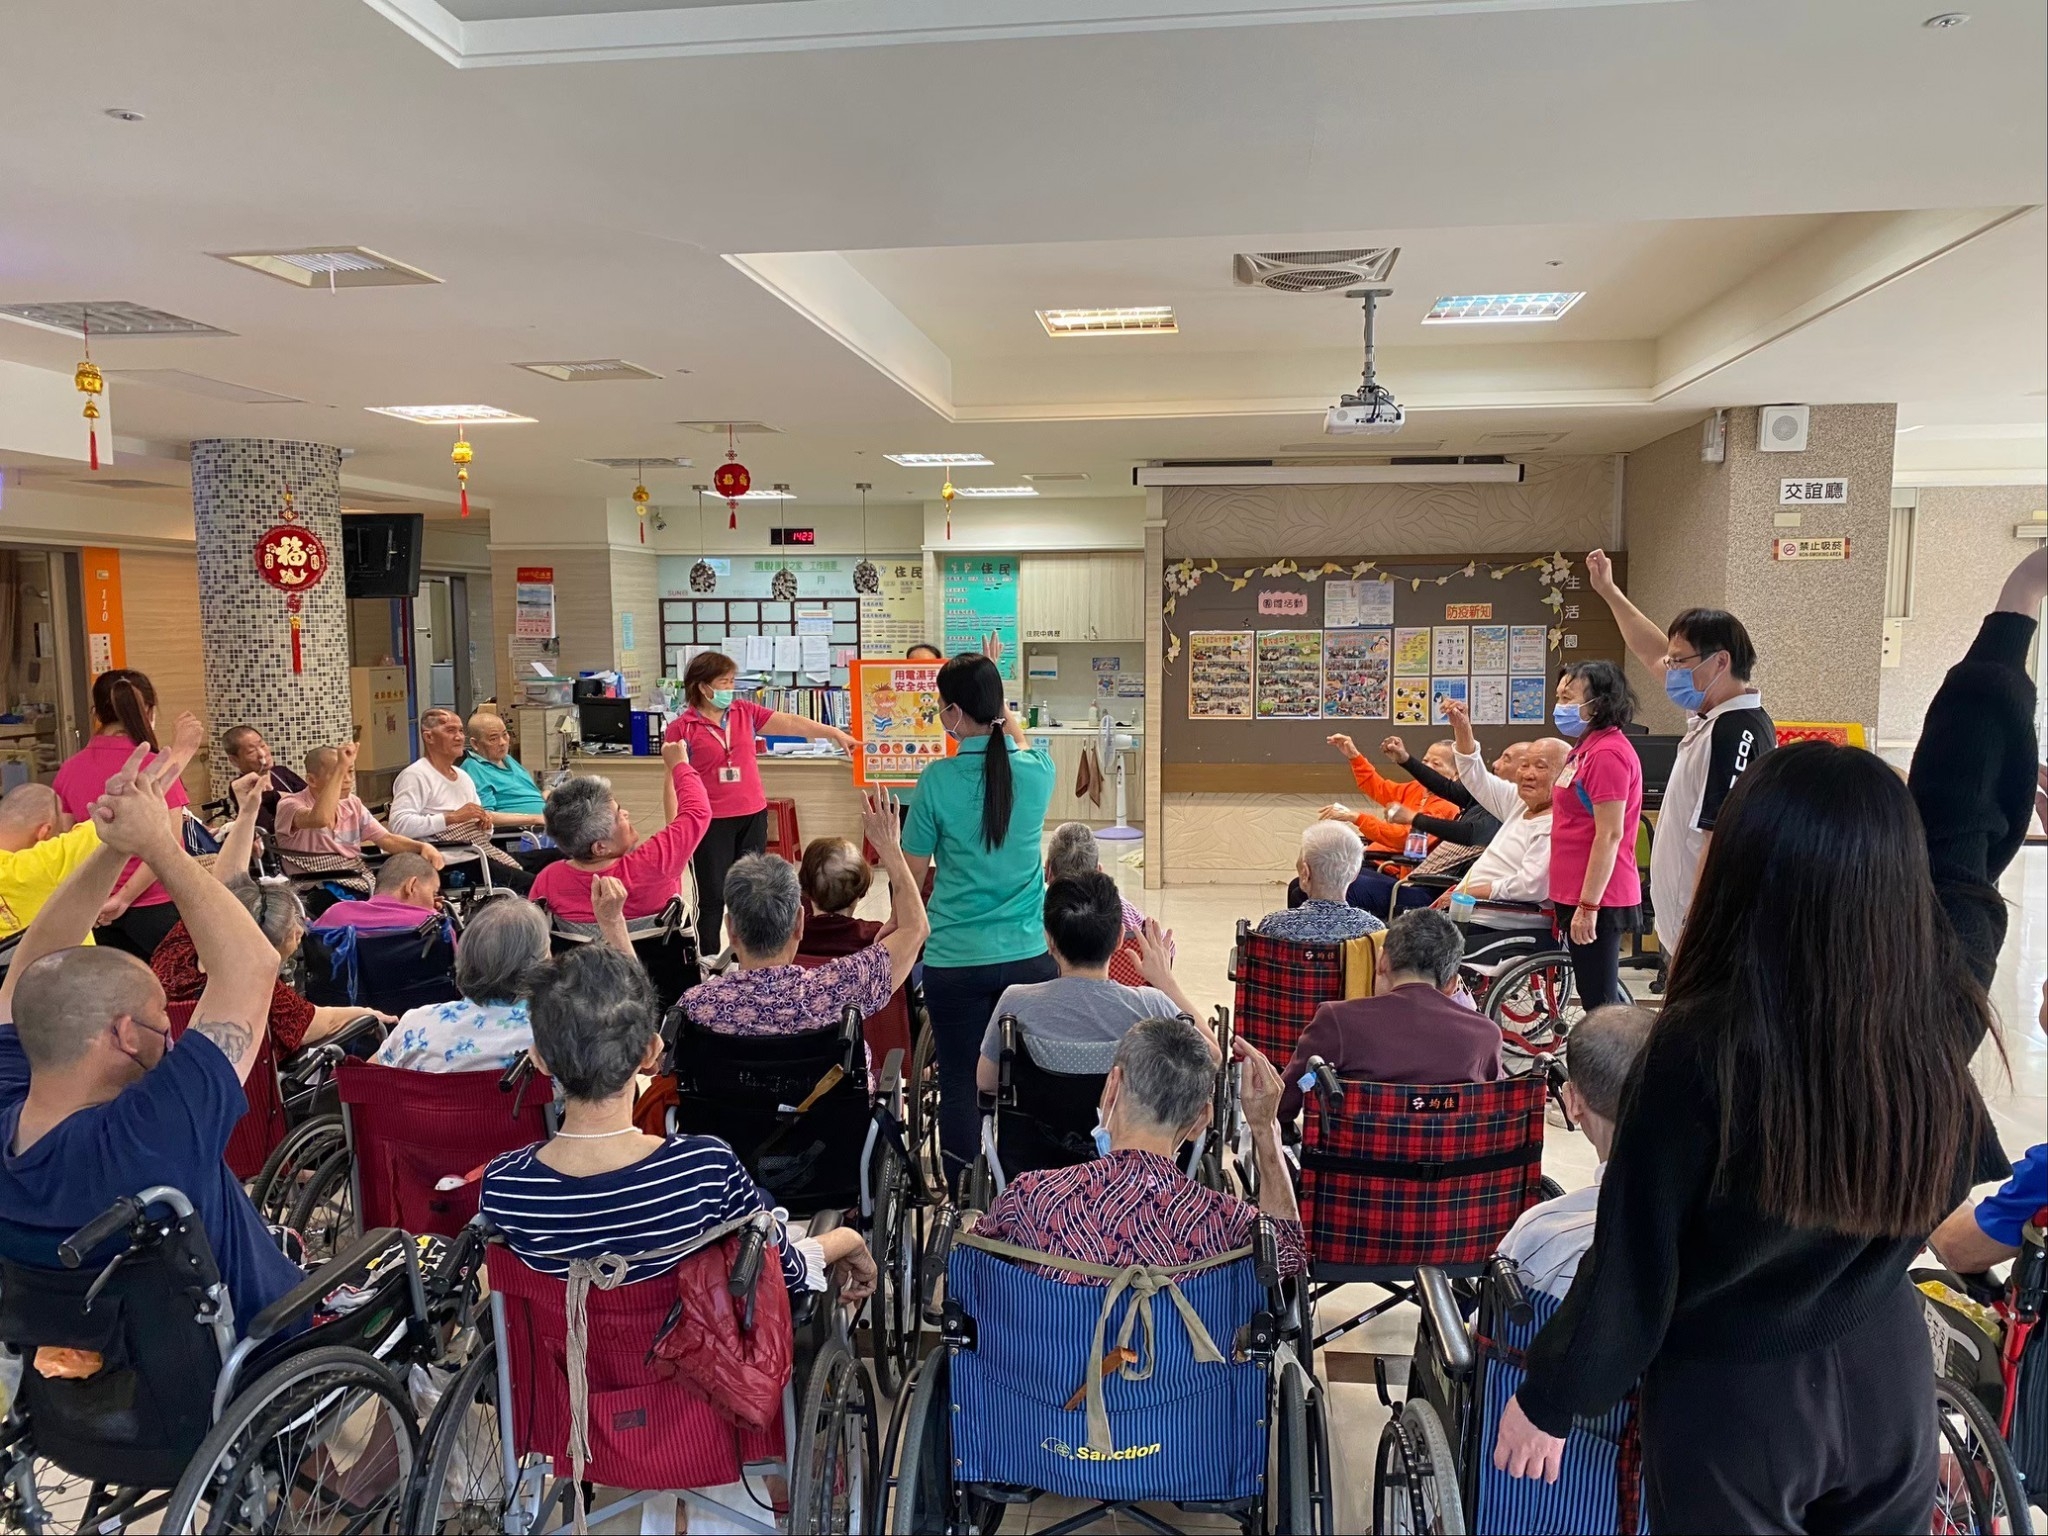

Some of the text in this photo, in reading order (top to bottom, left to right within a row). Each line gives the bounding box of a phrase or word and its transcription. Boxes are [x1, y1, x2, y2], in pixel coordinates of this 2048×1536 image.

[1785, 482, 1844, 500] 交誼廳
[793, 531, 813, 541] 1423
[275, 536, 308, 567] 福
[1799, 541, 1842, 551] 禁止吸菸
[101, 588, 109, 622] 110
[1446, 604, 1492, 619] 防疫新知
[1026, 630, 1061, 638] 住院中病歷
[895, 681, 938, 692] 安全失守
[1428, 1096, 1455, 1109] 均佳
